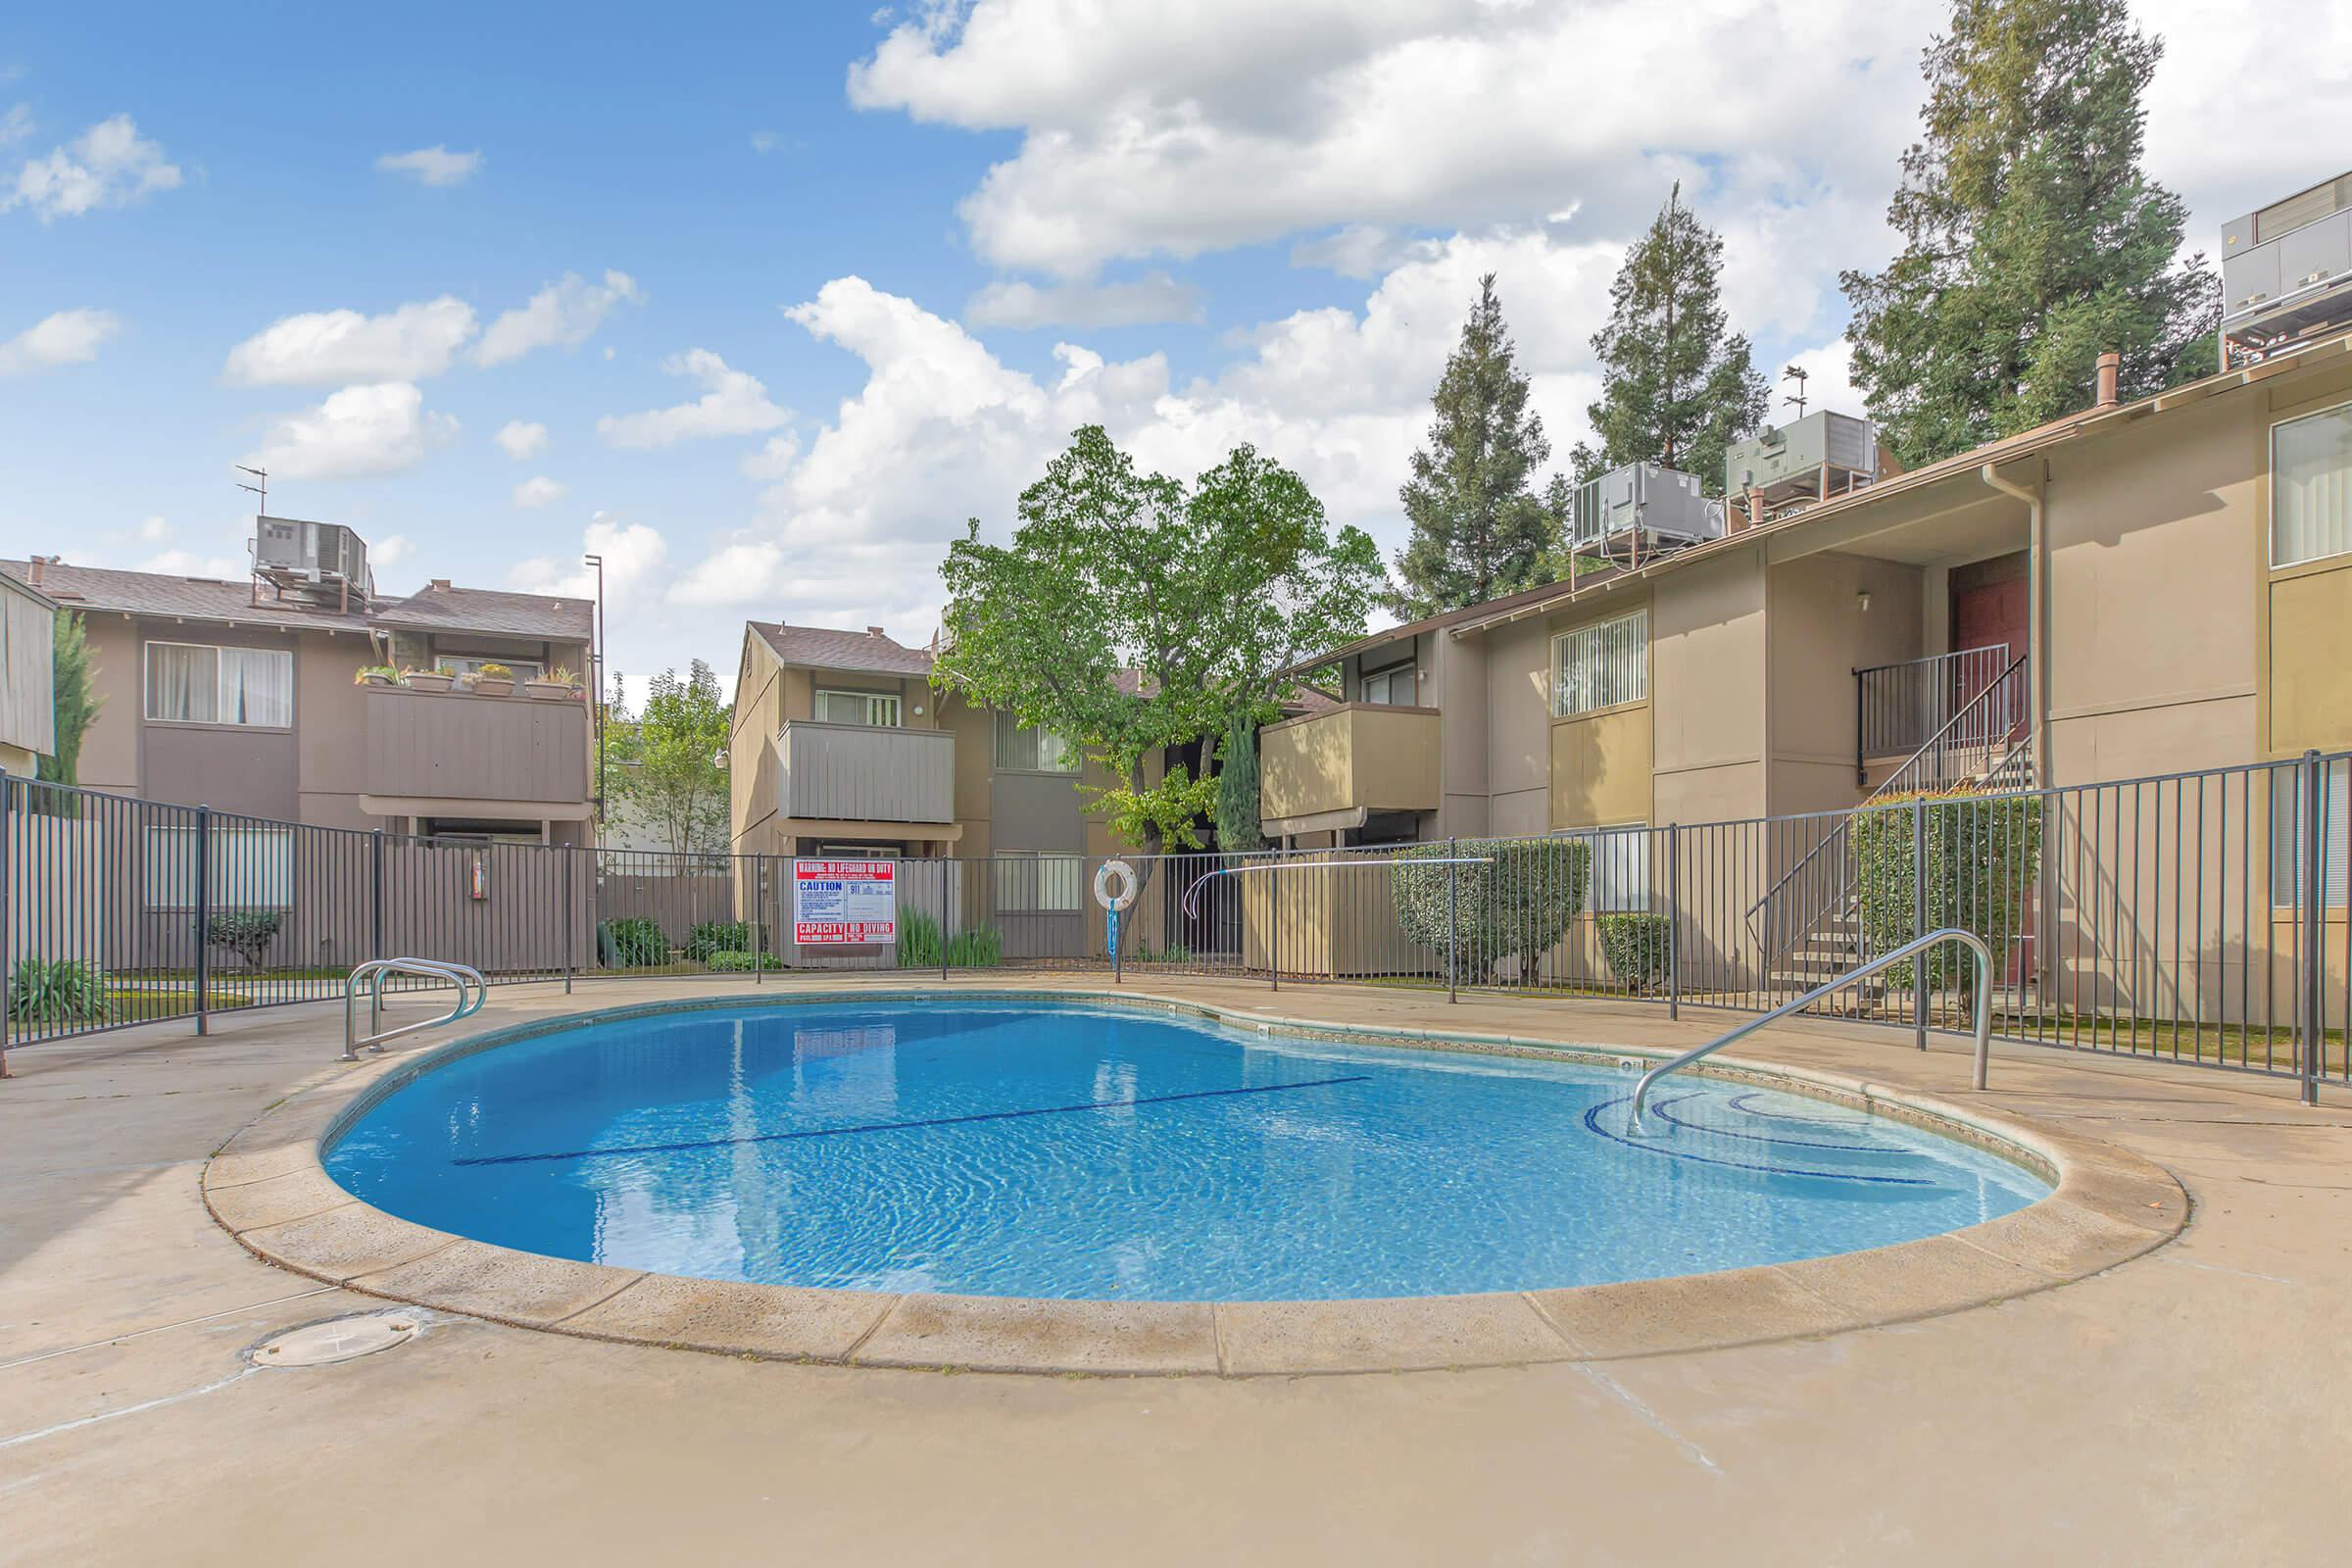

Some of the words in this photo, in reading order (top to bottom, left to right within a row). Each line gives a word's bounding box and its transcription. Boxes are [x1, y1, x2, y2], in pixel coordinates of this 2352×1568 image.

[799, 862, 827, 873] WARNING:
[828, 862, 836, 873] NO
[837, 862, 866, 873] LIFEGUARD
[867, 862, 875, 873] ON
[876, 862, 891, 873] DUTY
[800, 882, 842, 891] CAUTION
[850, 885, 860, 895] 911
[800, 923, 843, 933] CAPACITY
[850, 923, 860, 933] NO
[863, 923, 890, 933] DIVING
